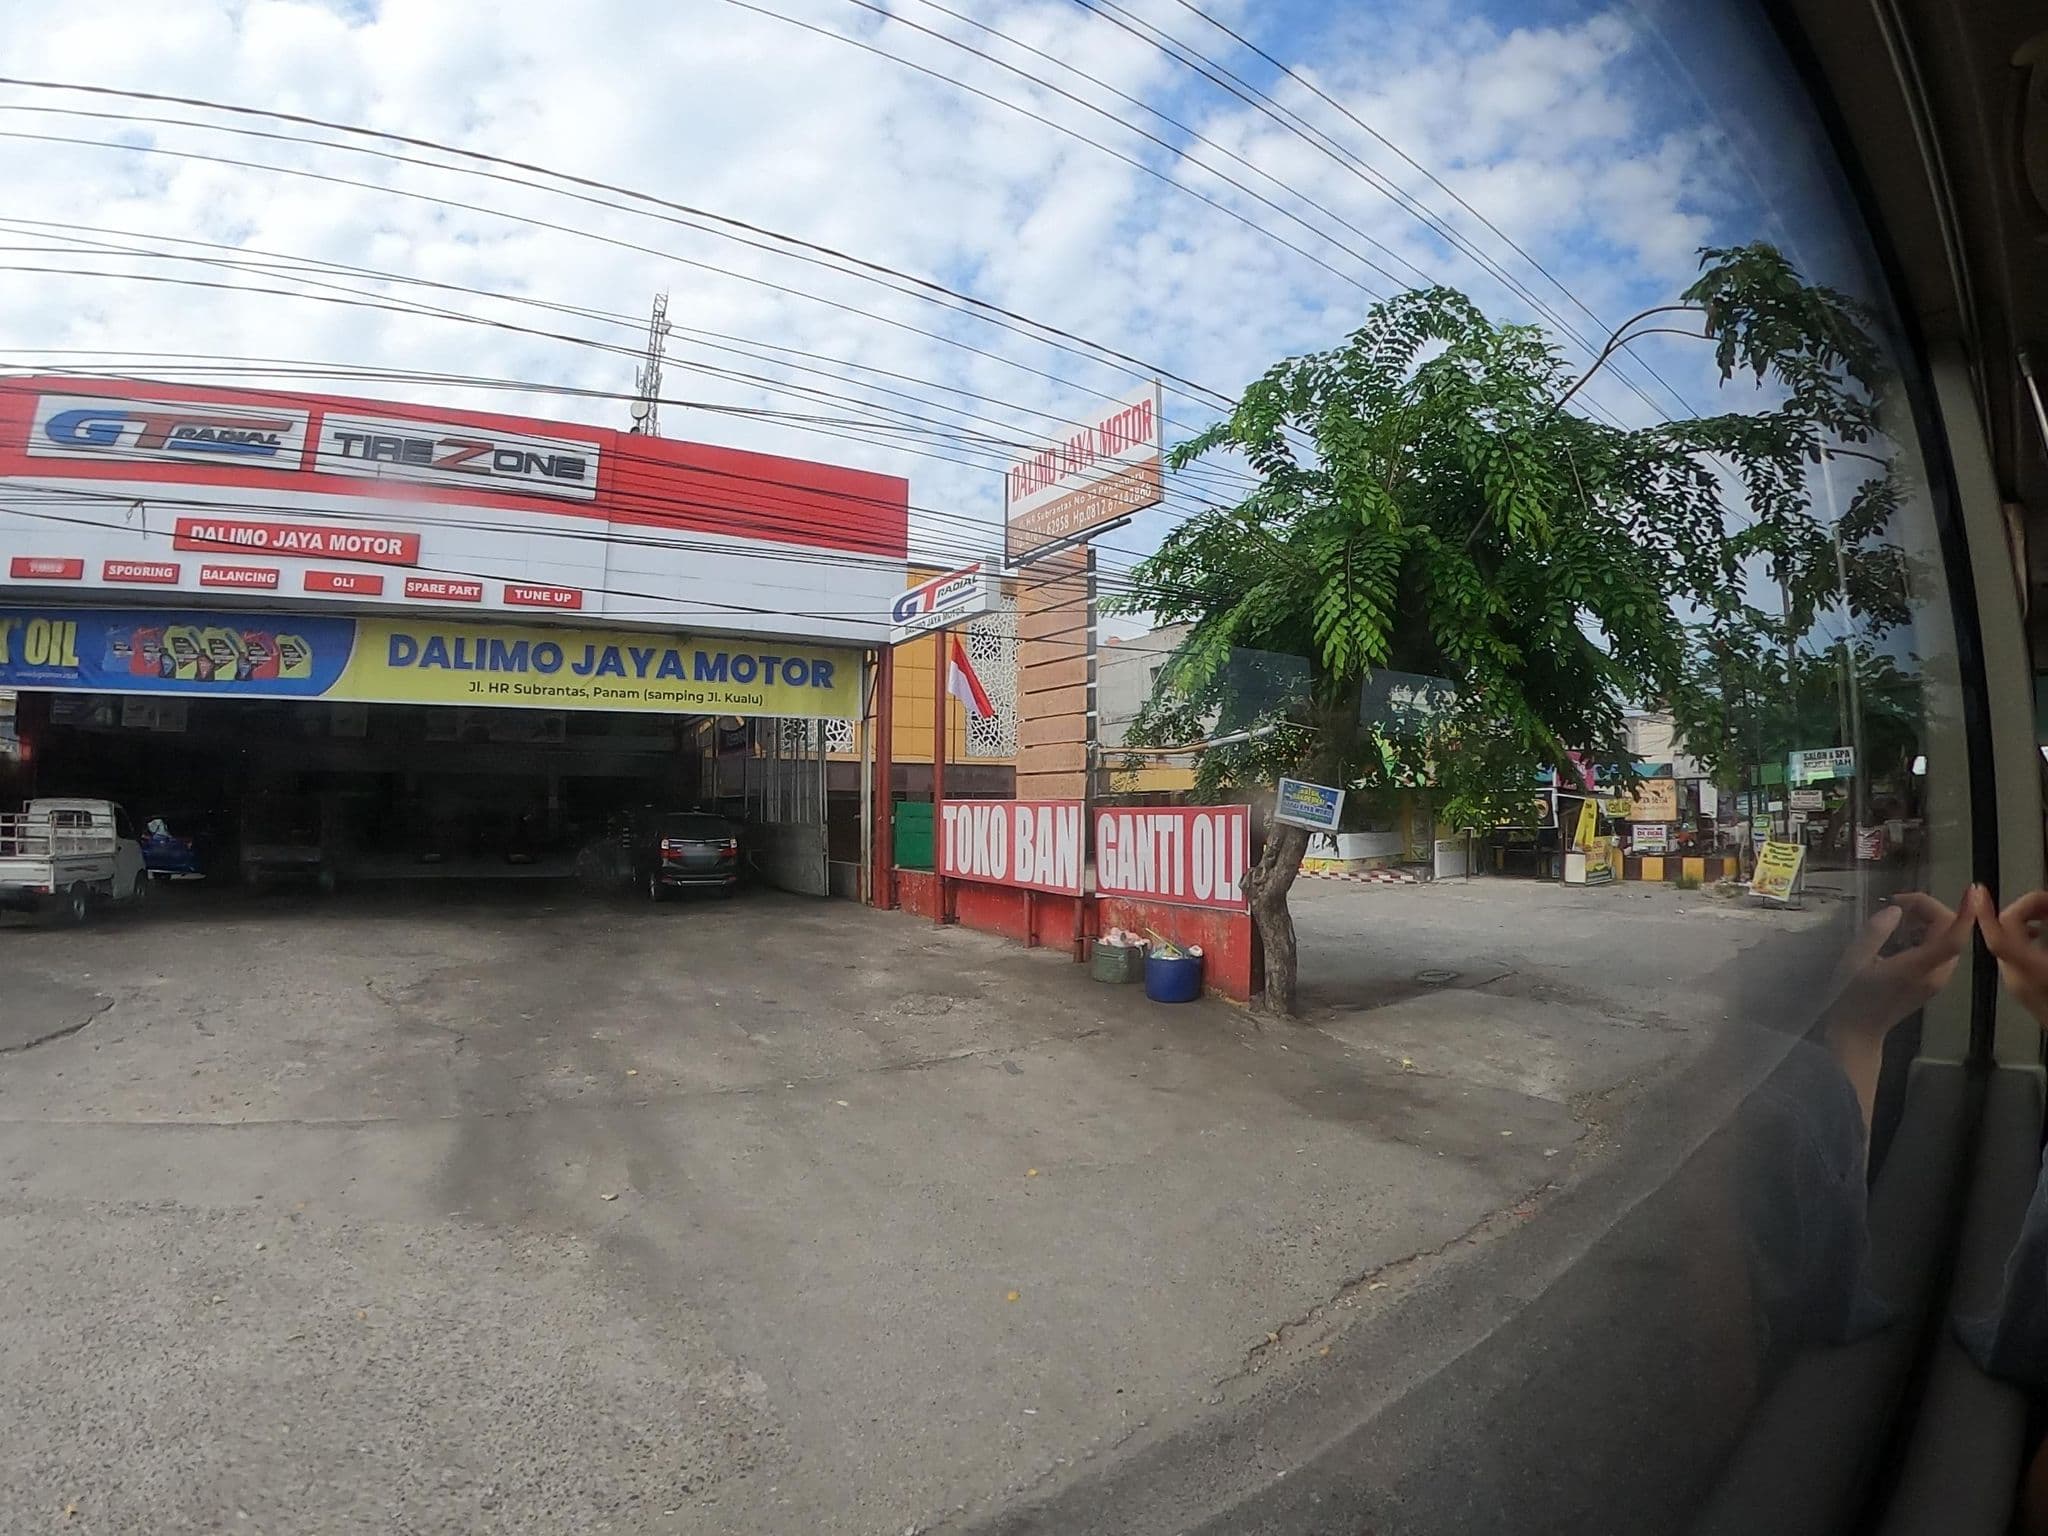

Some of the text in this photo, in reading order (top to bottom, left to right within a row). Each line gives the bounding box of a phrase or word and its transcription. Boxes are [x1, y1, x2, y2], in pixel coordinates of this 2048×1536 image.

[1060, 429, 1095, 480] JAYA
[1099, 398, 1153, 458] MOTOR
[190, 525, 403, 556] DALIMO JAYA MOTOR
[201, 569, 277, 584] BALANCING
[333, 576, 355, 589] OLI
[407, 582, 481, 597] SPARE PART
[937, 575, 978, 599] RADIAL
[515, 589, 572, 603] TUNE UP
[24, 618, 79, 667] OIL
[388, 633, 835, 689] DALIMO JAYA MOTOR
[468, 681, 763, 707] Jl. HR Subrantas, Panam (samping Jl. Kualu)
[1835, 749, 1850, 759] SPA
[943, 804, 1079, 889] TOKO BAN
[1099, 813, 1243, 901] GANTI OLI
